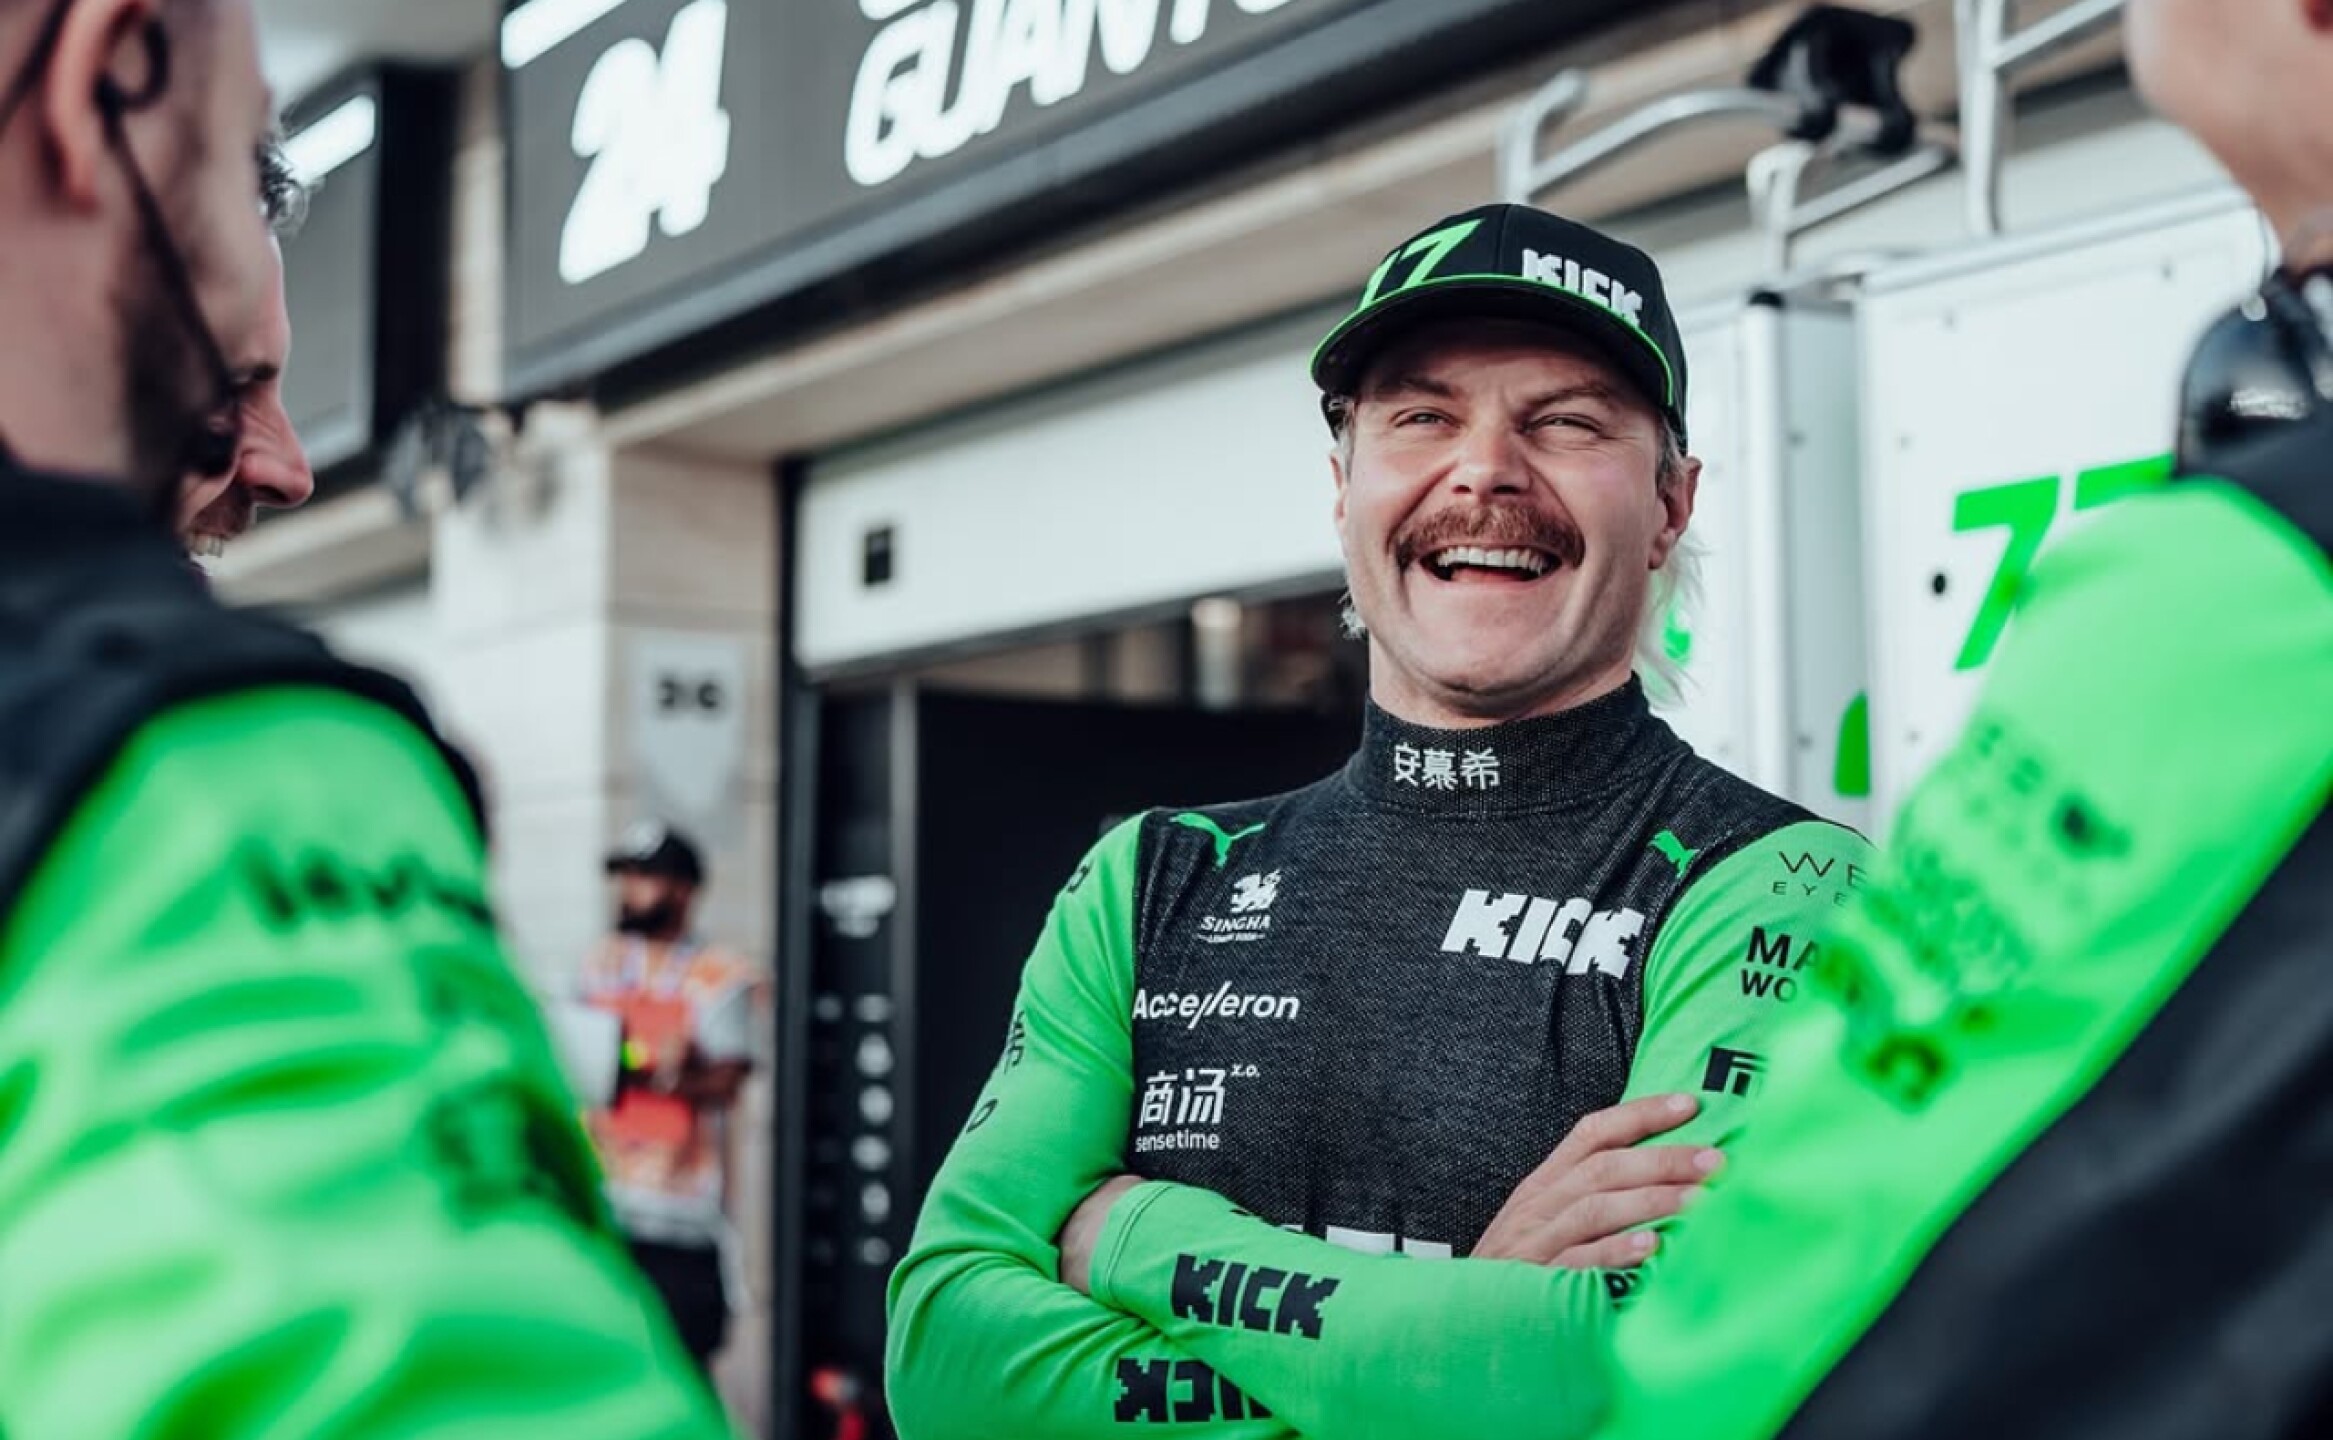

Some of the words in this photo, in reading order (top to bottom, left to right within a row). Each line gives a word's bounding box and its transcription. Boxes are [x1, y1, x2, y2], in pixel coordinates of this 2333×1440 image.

[844, 0, 1292, 186] GUAN
[559, 0, 729, 284] 24
[1521, 248, 1643, 328] KICK
[1395, 741, 1501, 790] 安慕希
[1200, 914, 1271, 932] SINGHA
[1441, 888, 1645, 979] KICK
[1139, 1067, 1226, 1129] 商汤
[1135, 1128, 1220, 1152] sensetime
[1172, 1254, 1340, 1340] KICK
[1115, 1358, 1273, 1423] ICK
